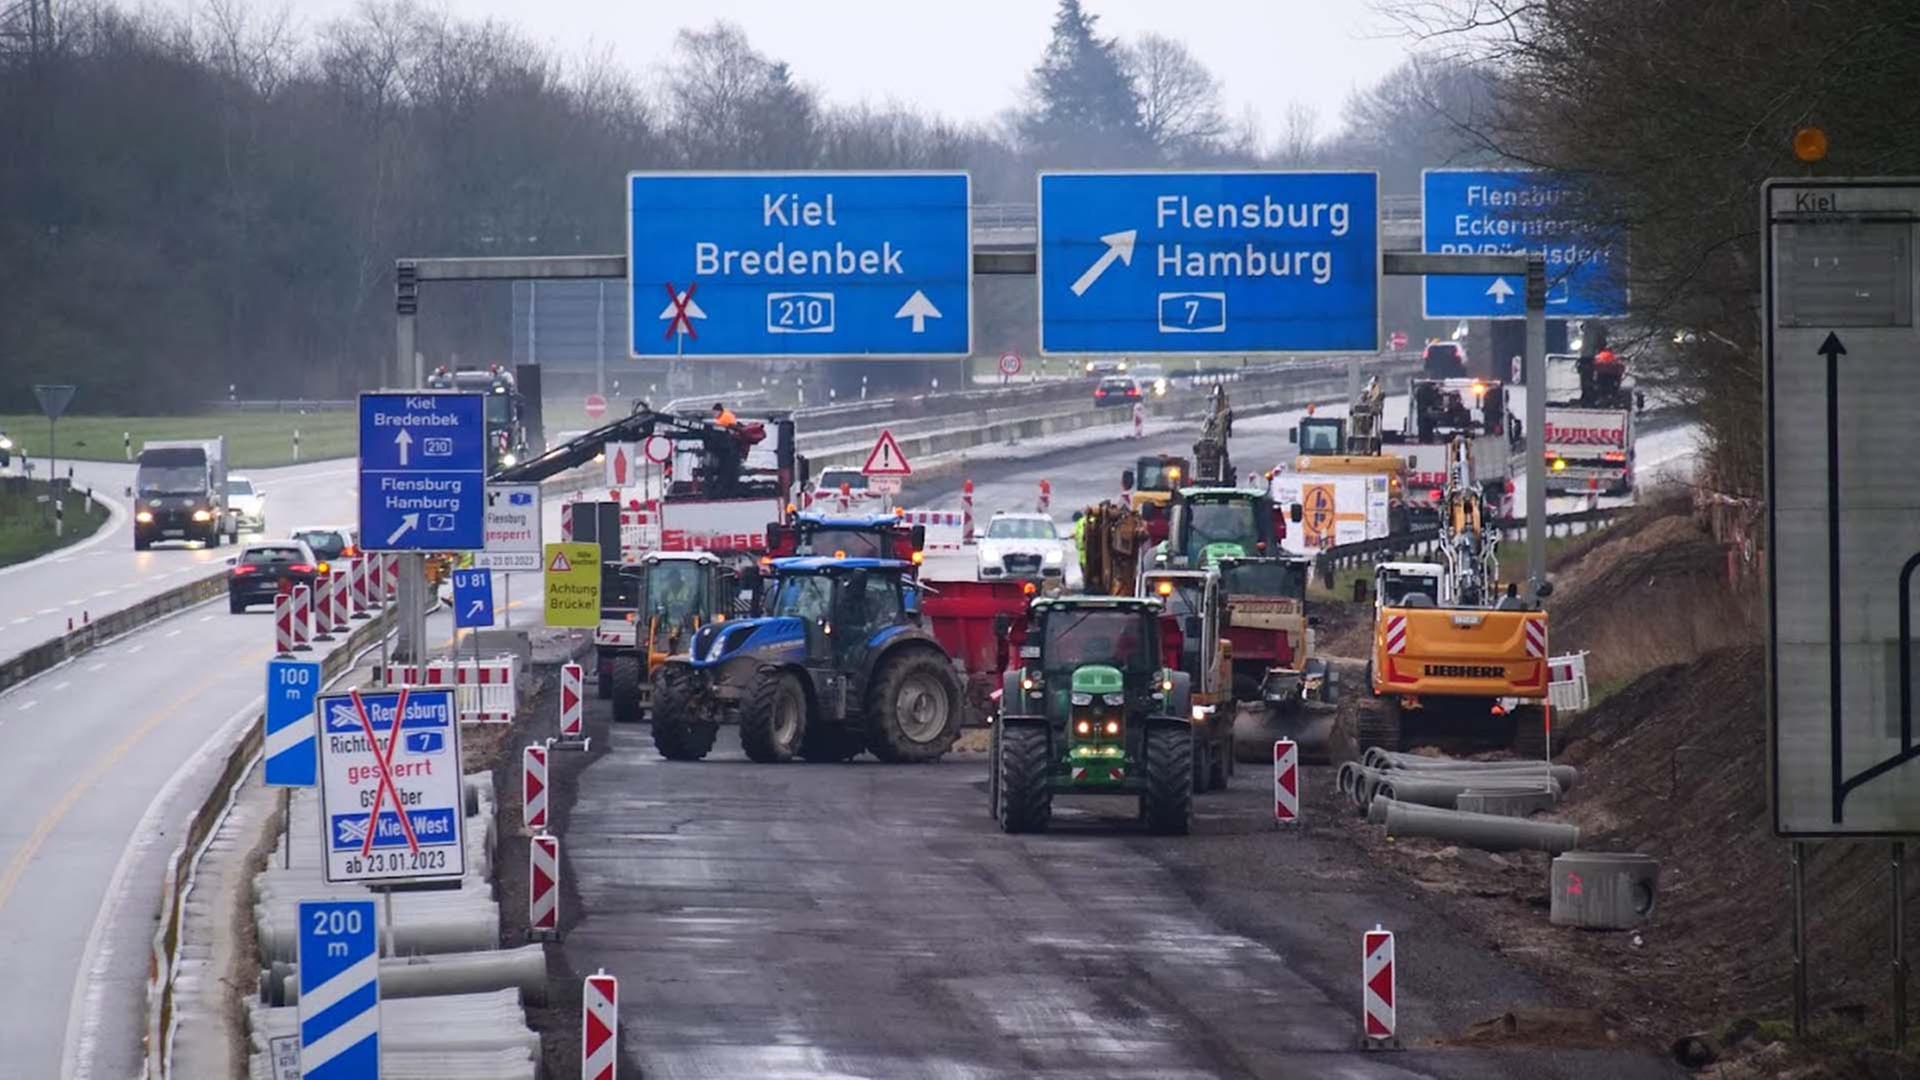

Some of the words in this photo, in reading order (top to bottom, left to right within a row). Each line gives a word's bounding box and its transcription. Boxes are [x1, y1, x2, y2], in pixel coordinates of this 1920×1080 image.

[764, 193, 836, 227] Kiel
[1796, 192, 1838, 212] Kiel
[1157, 195, 1350, 236] Flensburg
[696, 241, 904, 275] Bredenbek
[1157, 244, 1332, 284] Hamburg
[779, 301, 823, 325] 210
[1185, 301, 1200, 324] 7
[405, 396, 437, 410] Kiel
[374, 413, 459, 427] Bredenbek
[427, 440, 448, 453] 210
[381, 477, 462, 494] Flensburg
[385, 497, 460, 512] Hamburg
[436, 516, 445, 529] 7
[488, 512, 527, 526] Flensburg
[455, 575, 467, 588] U
[471, 574, 486, 588] 81
[550, 584, 598, 597] Achtung
[279, 667, 309, 685] 100
[1424, 664, 1505, 678] LIEBHERR
[286, 689, 301, 700] m
[371, 701, 447, 722] Rensburg
[419, 733, 431, 751] 7
[387, 788, 423, 806] ber
[346, 858, 363, 874] ab
[367, 851, 446, 873] 23.01.2023
[313, 910, 362, 936] 200
[328, 942, 349, 957] m
